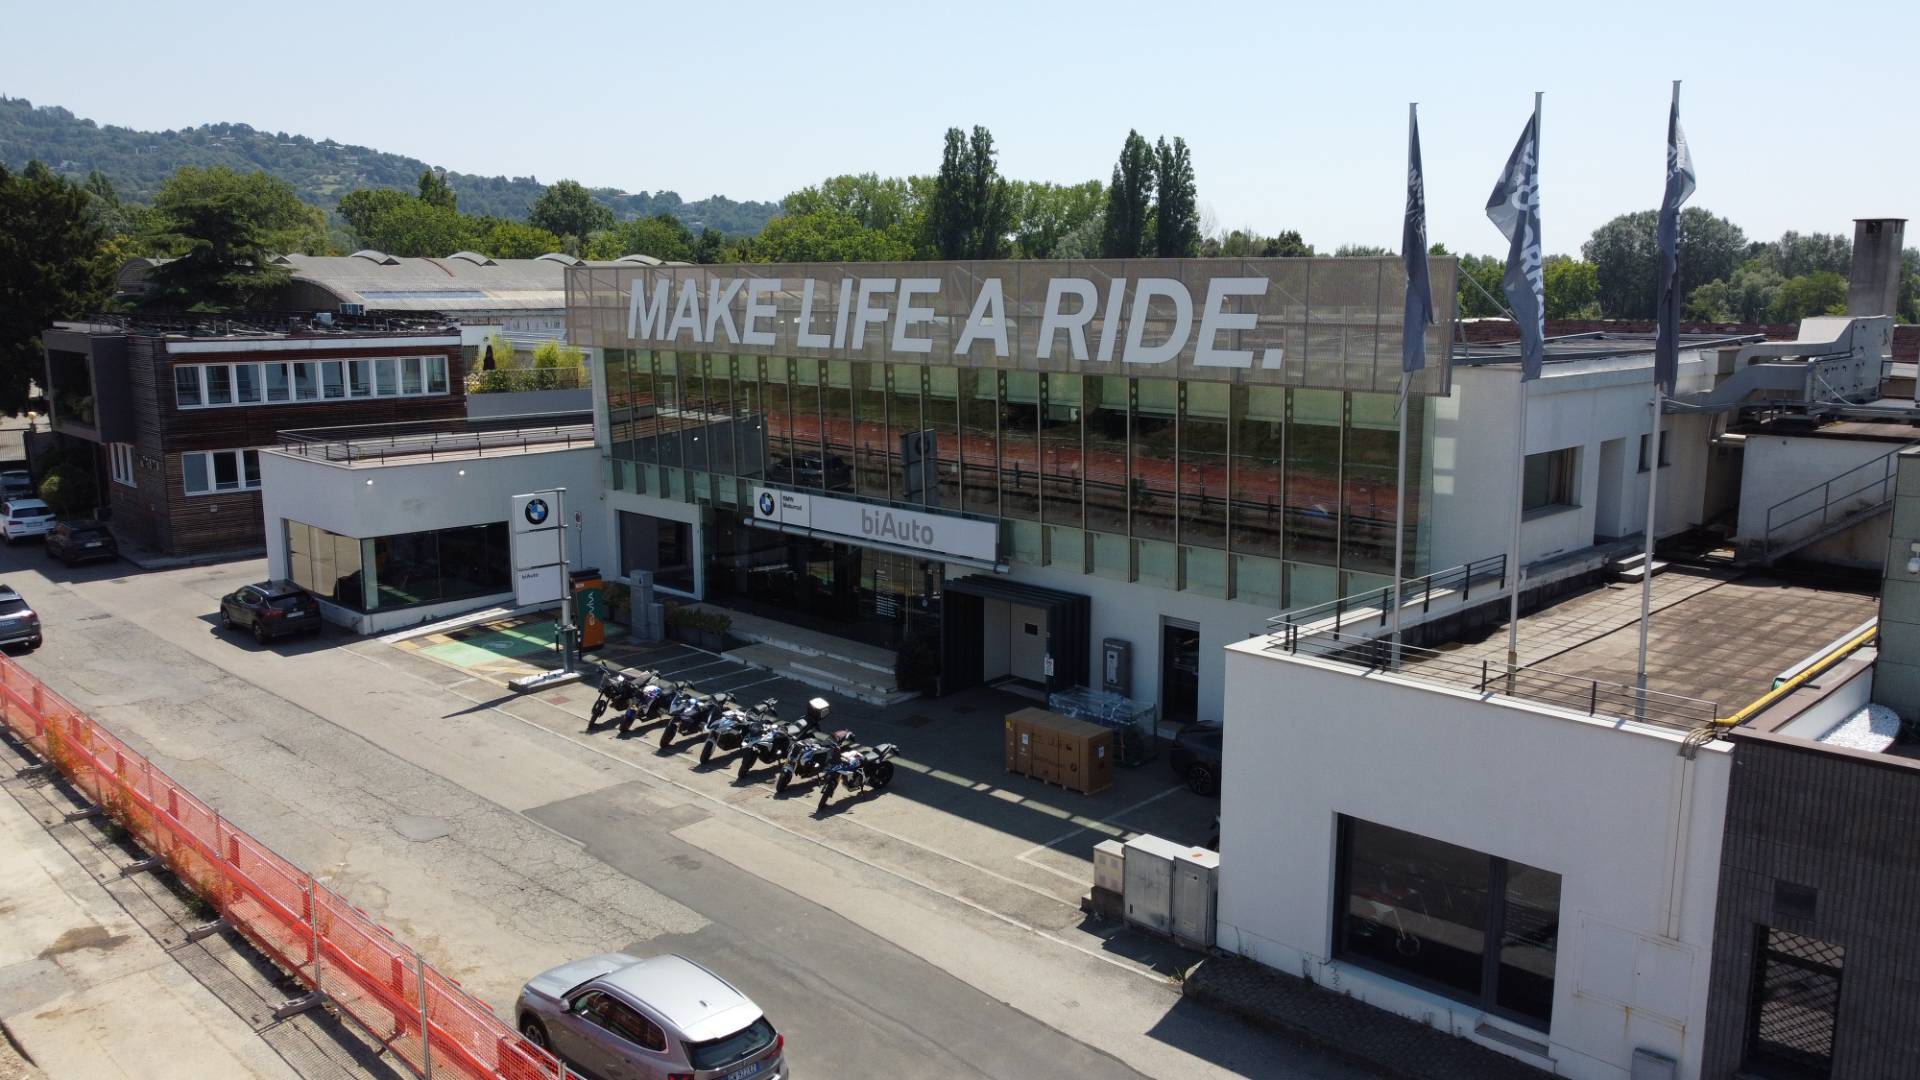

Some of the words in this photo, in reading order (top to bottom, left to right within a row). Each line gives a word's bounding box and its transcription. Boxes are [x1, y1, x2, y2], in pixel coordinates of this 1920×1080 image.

[627, 277, 782, 346] MAKE
[796, 277, 941, 353] LIFE
[953, 277, 1009, 357] A
[1036, 276, 1284, 370] RIDE.
[861, 508, 934, 545] biAuto
